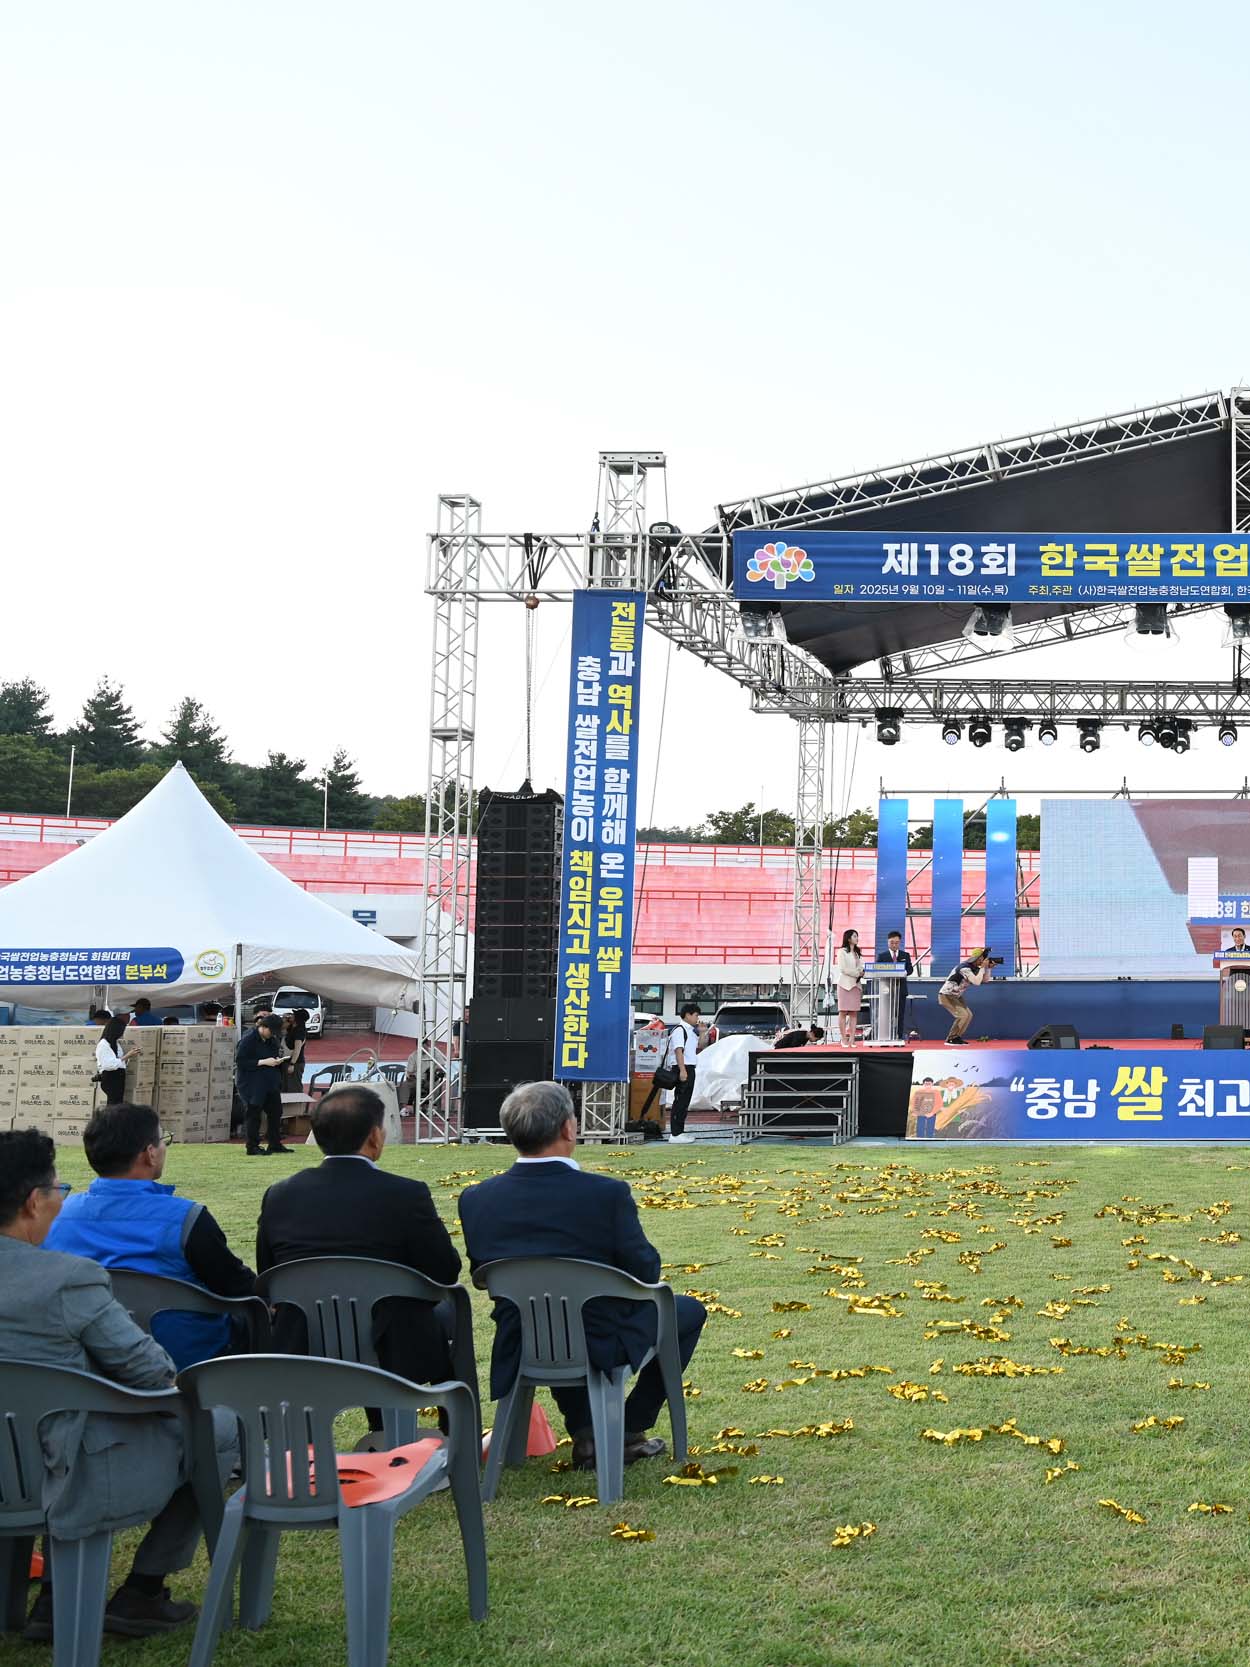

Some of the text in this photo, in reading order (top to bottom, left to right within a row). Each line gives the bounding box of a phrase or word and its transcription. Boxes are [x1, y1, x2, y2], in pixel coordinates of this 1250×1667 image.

[881, 542, 1016, 577] 제18회
[833, 584, 854, 595] 일자
[860, 584, 899, 595] 2025년
[902, 584, 919, 595] 9월
[923, 584, 945, 595] 10일
[596, 601, 636, 999] 전통과 역사를 함께해 온 우리 쌀!
[561, 655, 602, 1069] 충남 쌀전업농이 책임지고 생산한다
[0, 951, 130, 962] 국쌀전업농충청남도 회원대회
[125, 964, 168, 981] 본부석
[1010, 1076, 1101, 1120] “충남
[1110, 1066, 1168, 1121] 쌀
